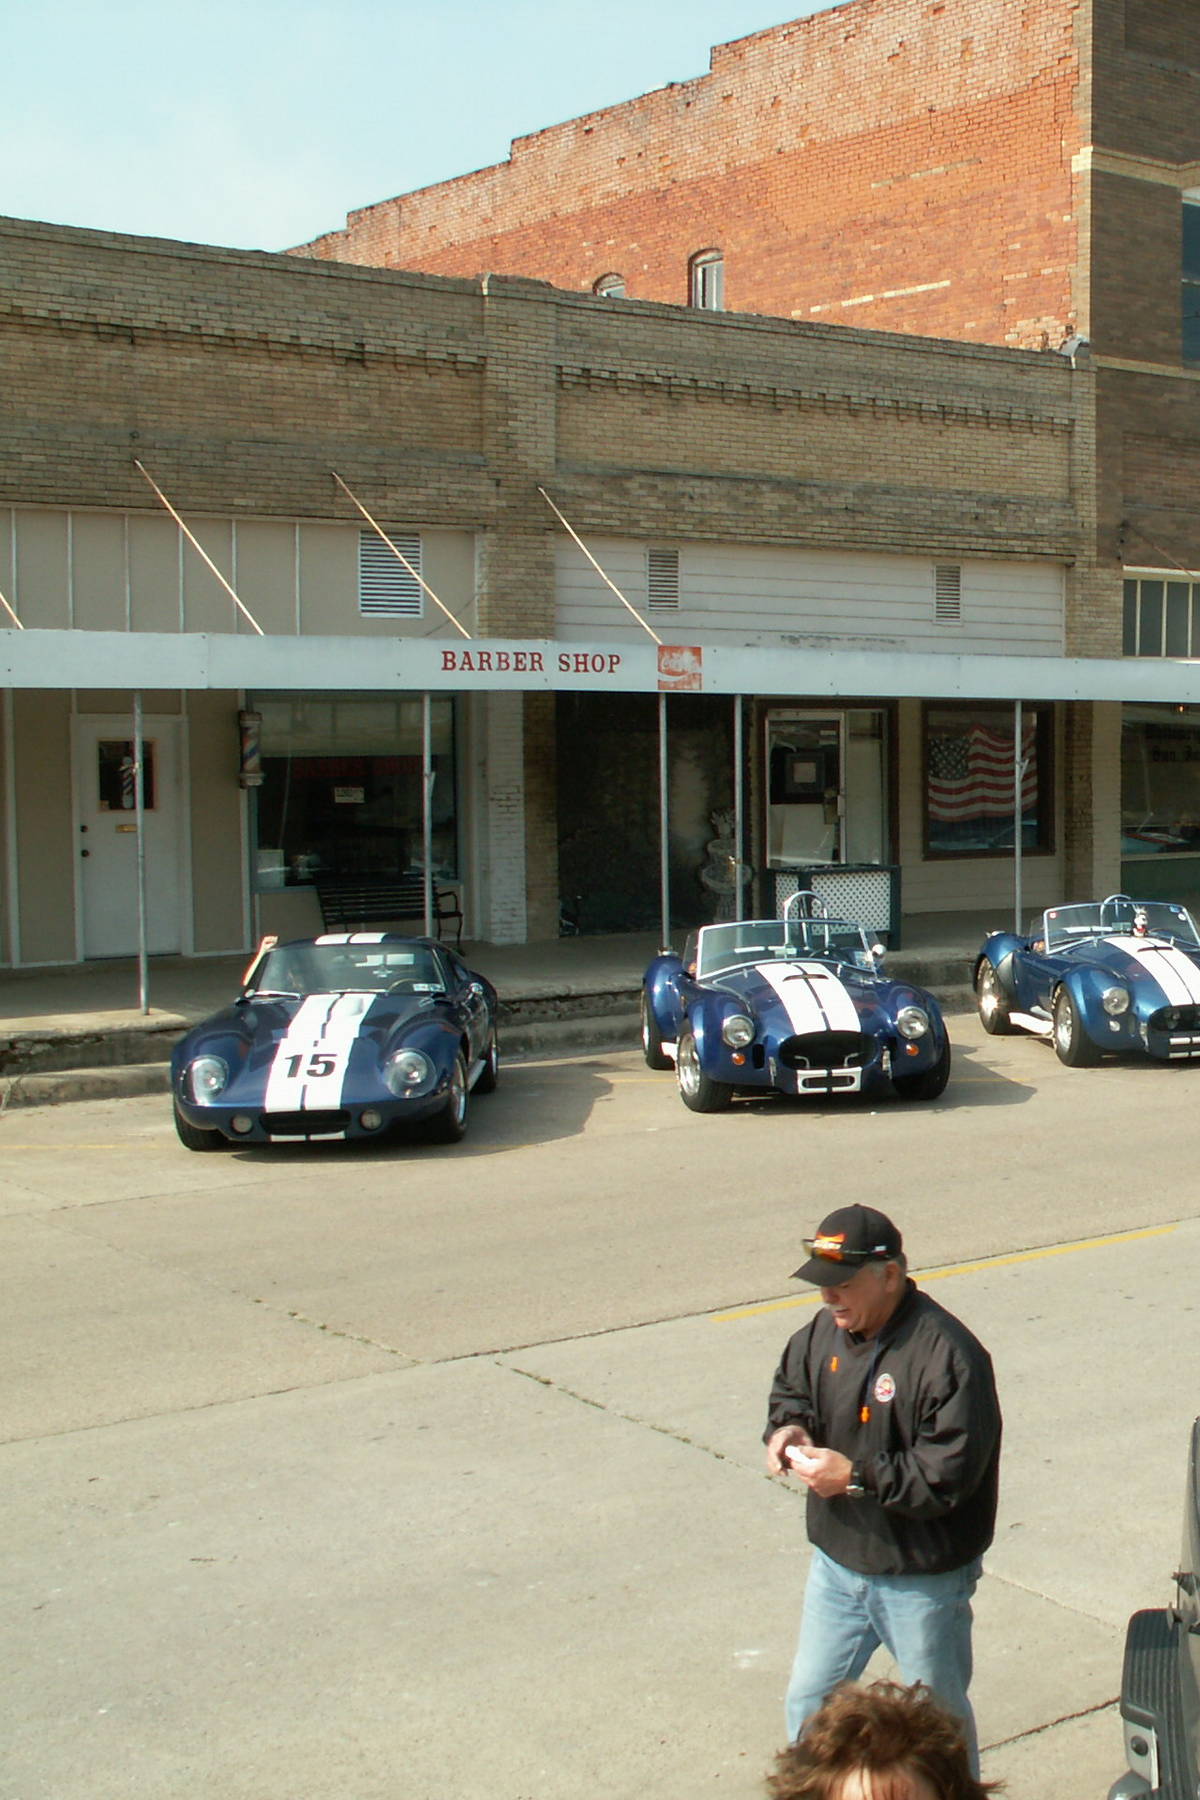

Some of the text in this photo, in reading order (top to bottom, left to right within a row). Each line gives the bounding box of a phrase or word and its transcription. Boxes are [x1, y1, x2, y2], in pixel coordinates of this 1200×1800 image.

[441, 650, 622, 674] BARBER SHOP
[284, 1053, 338, 1079] 15
